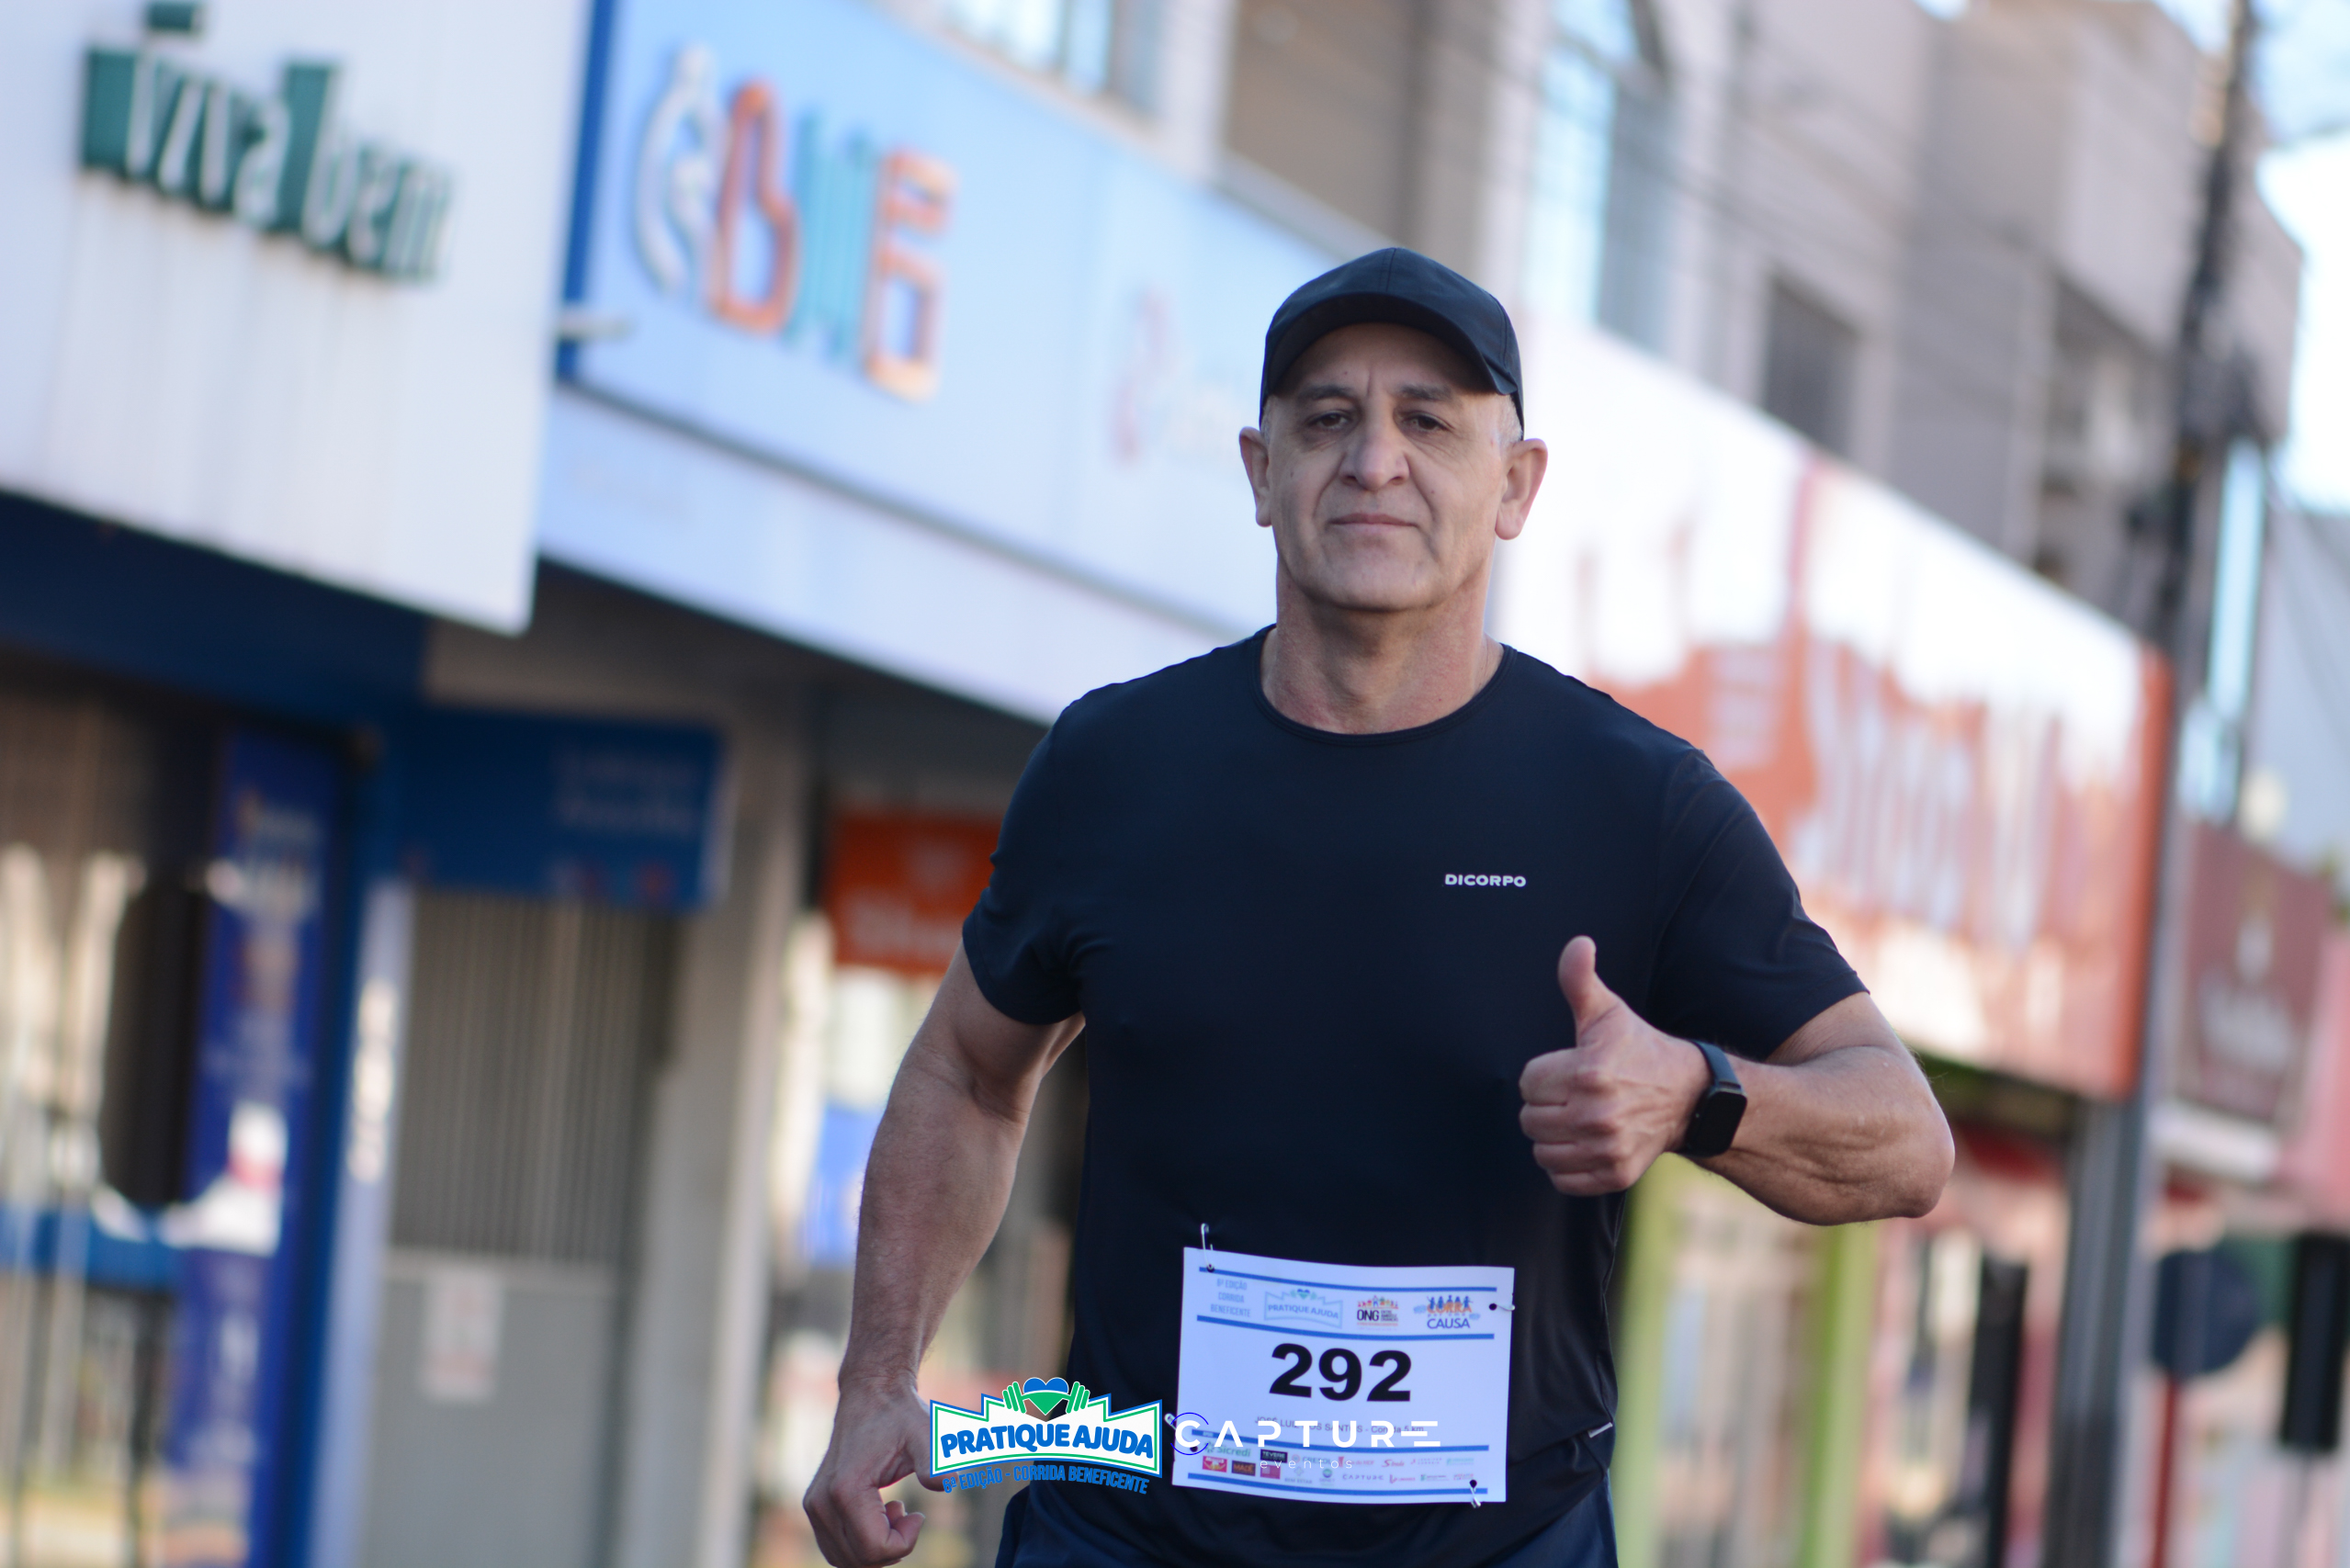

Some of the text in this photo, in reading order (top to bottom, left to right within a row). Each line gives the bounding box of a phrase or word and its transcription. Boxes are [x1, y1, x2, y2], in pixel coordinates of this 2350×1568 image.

[1444, 874, 1527, 887] DICORPO
[1218, 1292, 1245, 1303] CORRIDA
[1210, 1303, 1251, 1317] BENEFICENTE
[1268, 1304, 1339, 1319] PRATIQUE AJUDA
[1357, 1309, 1380, 1322] ONG
[1427, 1318, 1471, 1329] CAUSA
[1269, 1342, 1412, 1403] 292
[1217, 1445, 1251, 1457] Sicredi
